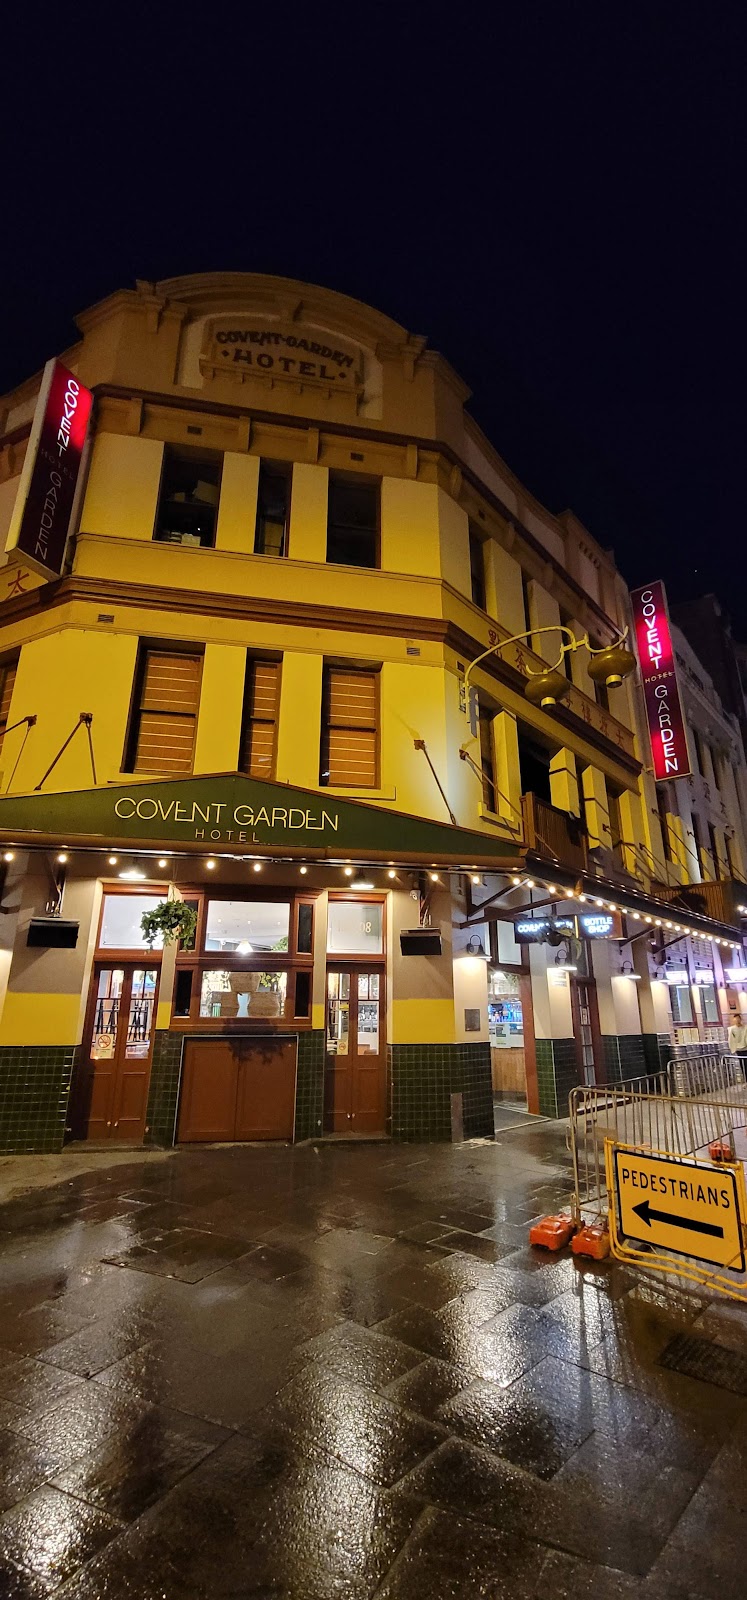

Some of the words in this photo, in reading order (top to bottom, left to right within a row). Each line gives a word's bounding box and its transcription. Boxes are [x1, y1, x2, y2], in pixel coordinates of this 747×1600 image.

[232, 348, 336, 380] HOTEL
[56, 379, 80, 457] COVENT
[35, 471, 62, 560] GARDEN
[641, 590, 663, 670] COVENT
[644, 671, 675, 684] HOTEL
[654, 684, 679, 775] GARDEN
[115, 797, 227, 824] COVENT
[234, 805, 339, 831] GARDEN
[195, 828, 260, 843] HOTEL
[583, 916, 613, 927] BOTTLE
[588, 924, 610, 934] SHOP
[622, 1167, 731, 1209] PEDESTRIANS
